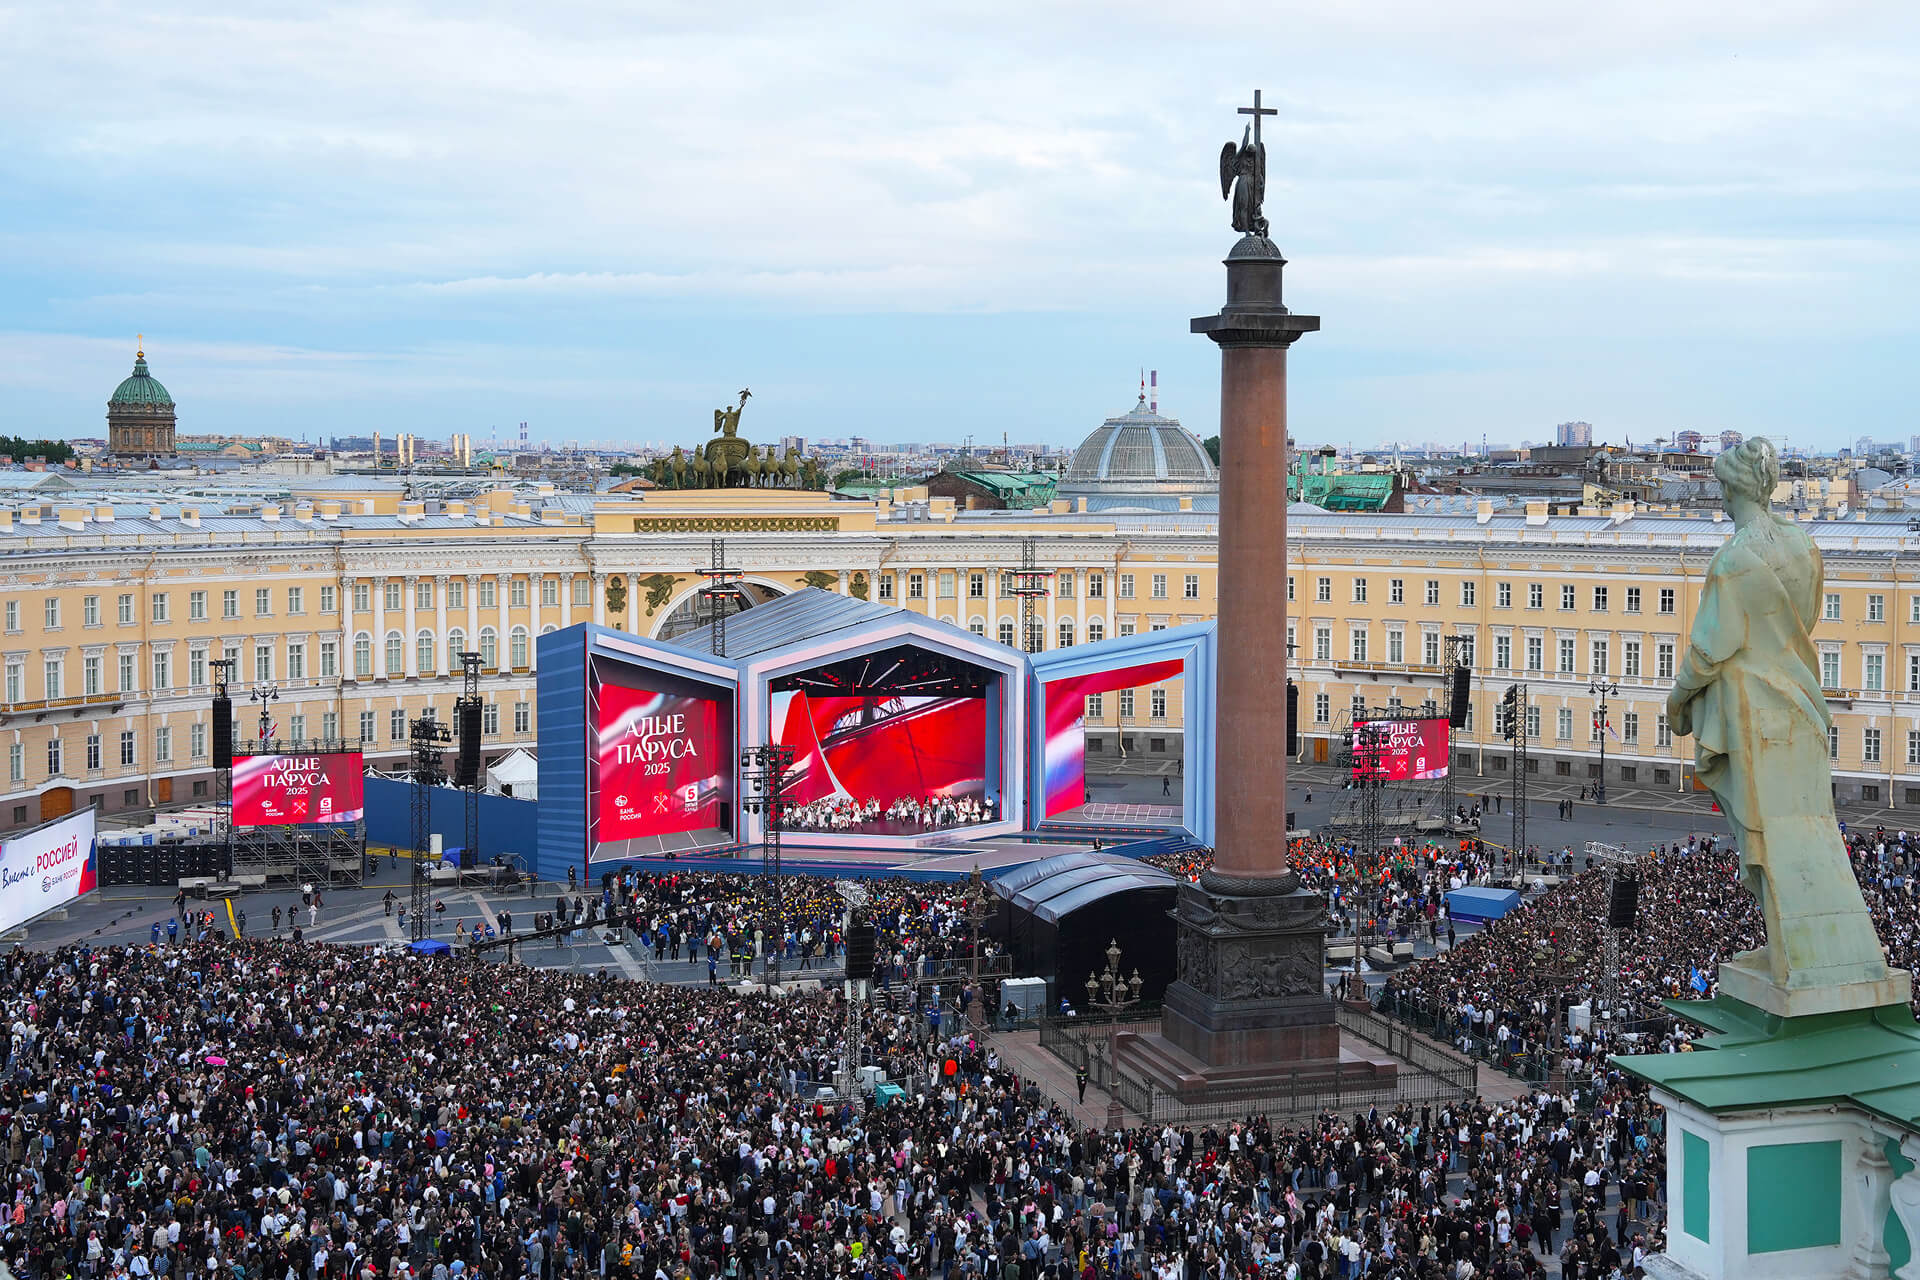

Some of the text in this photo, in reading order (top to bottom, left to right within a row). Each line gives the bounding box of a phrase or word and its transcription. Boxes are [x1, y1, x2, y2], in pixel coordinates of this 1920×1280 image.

[625, 714, 685, 738] АЛЫЕ
[616, 736, 697, 764] ПАРУСА
[1391, 748, 1408, 756] 2025
[270, 757, 320, 771] АЛЫЕ
[644, 762, 670, 775] 2025
[263, 771, 330, 787] ПАРУСА
[286, 787, 308, 795] 2025
[687, 788, 696, 800] 5
[37, 834, 77, 872] РОССИЕЙ
